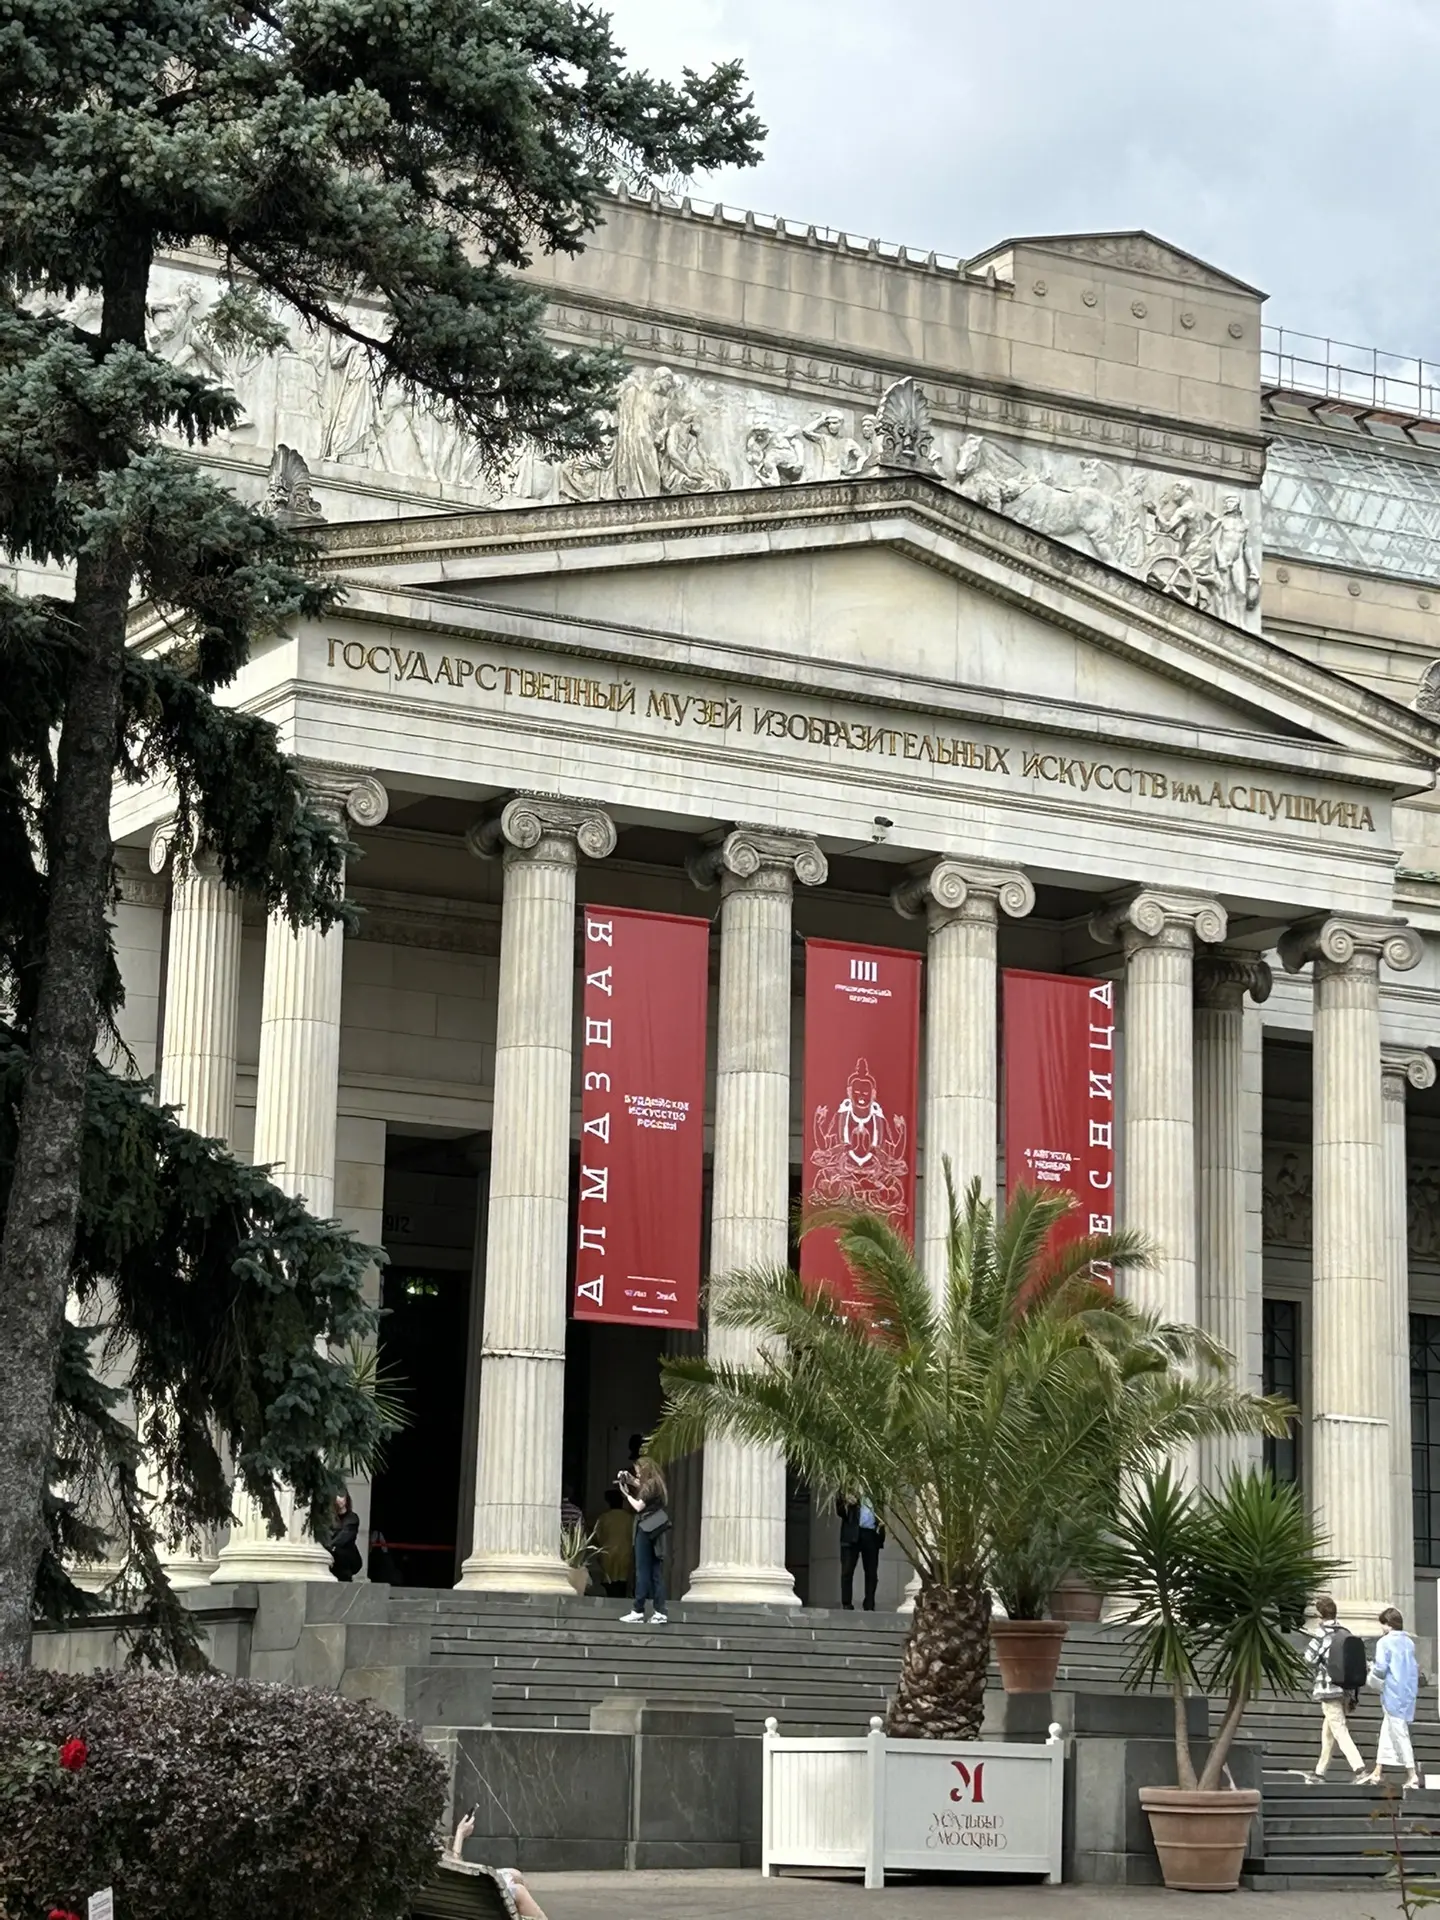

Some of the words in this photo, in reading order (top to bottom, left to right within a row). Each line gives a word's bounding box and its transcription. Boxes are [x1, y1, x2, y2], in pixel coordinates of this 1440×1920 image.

[326, 637, 636, 716] ГОСУДАРСТВЕННЫЙ
[646, 688, 743, 734] МУЗЕЙ
[753, 706, 1011, 776] ИЗОБРАЗИТЕЛЬНЫХ
[1021, 751, 1168, 799] ИСКУССТВ
[577, 919, 614, 1306] АЛМАЗНАЯ
[1088, 980, 1115, 1287] ЛЕСНИЦА
[926, 1831, 1007, 1850] МОСКВЫ
